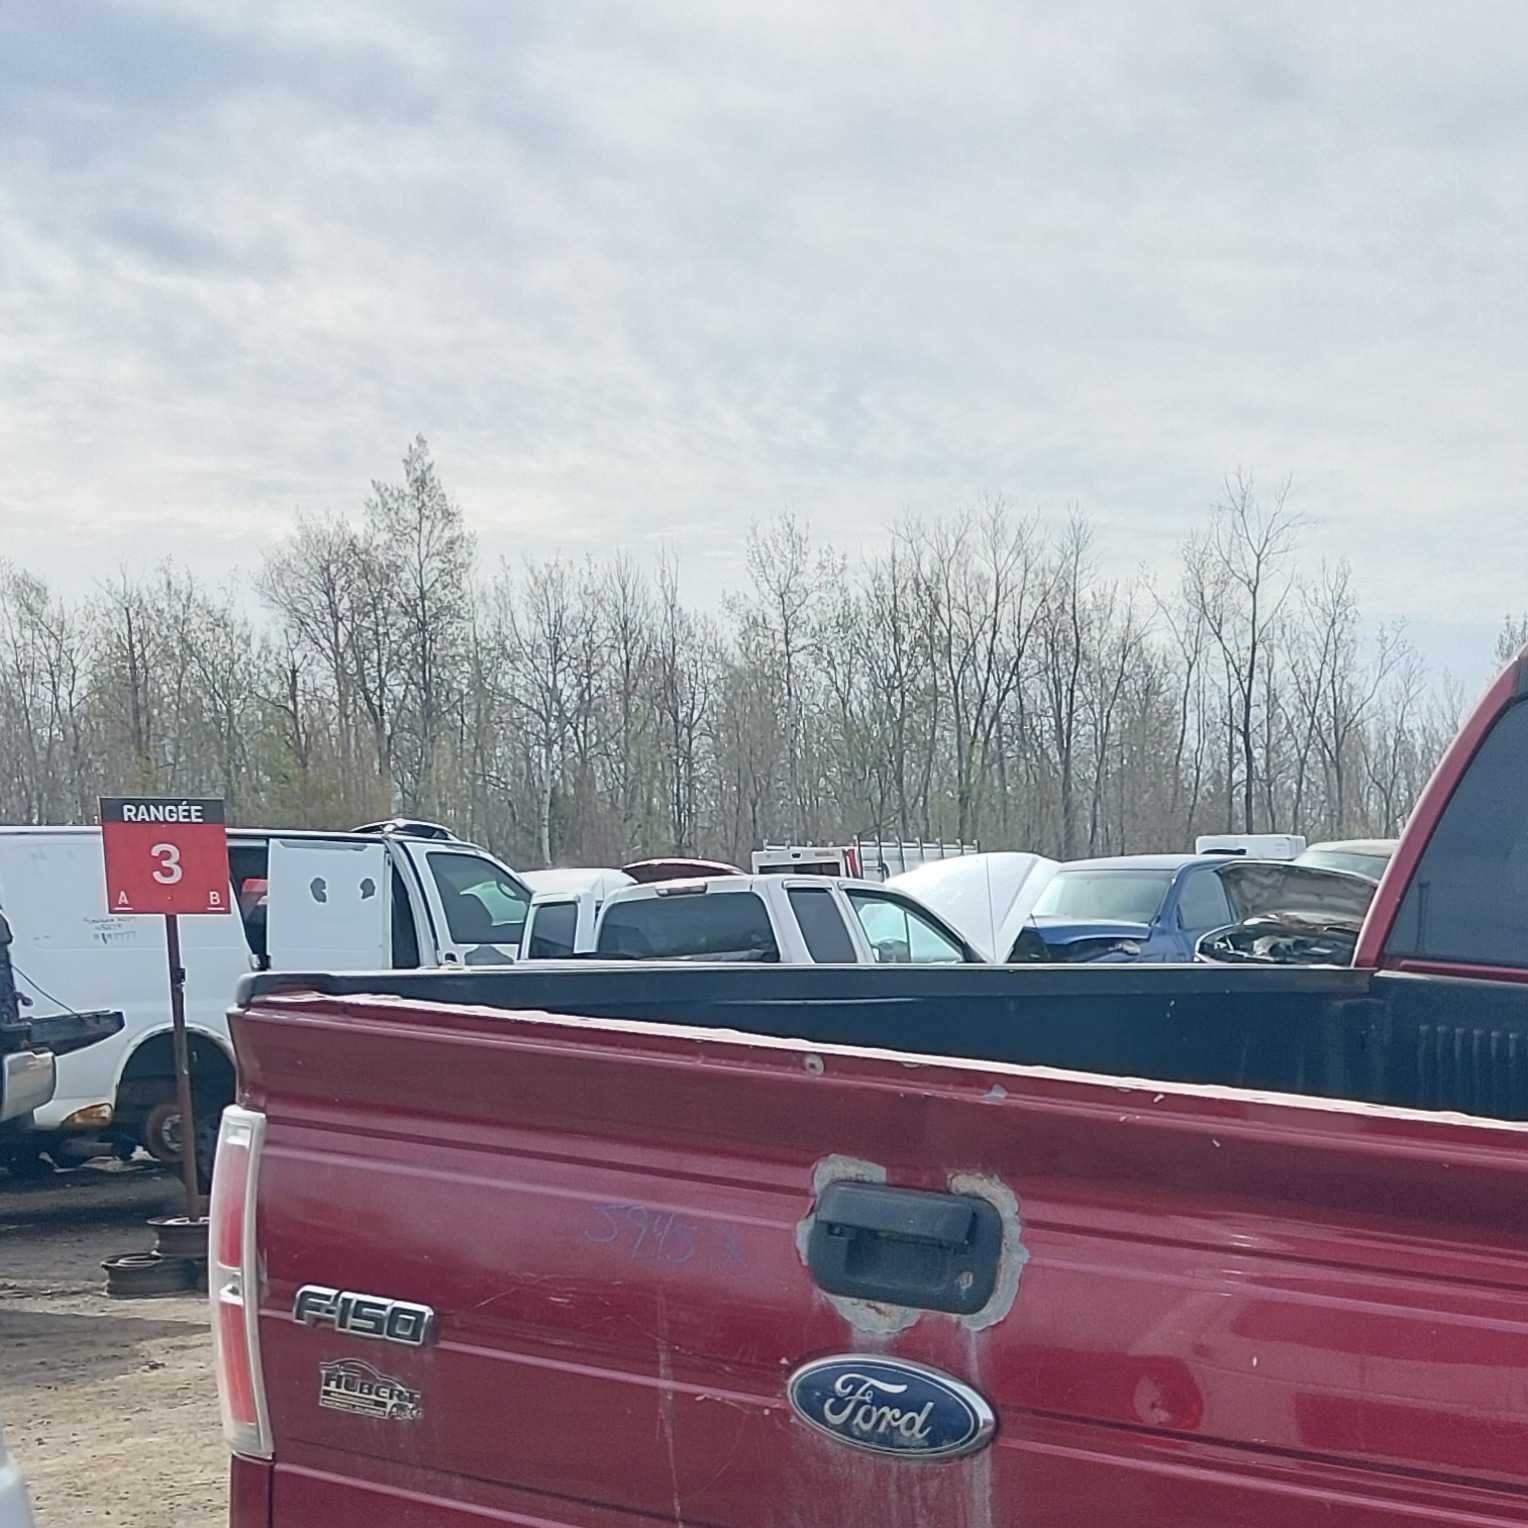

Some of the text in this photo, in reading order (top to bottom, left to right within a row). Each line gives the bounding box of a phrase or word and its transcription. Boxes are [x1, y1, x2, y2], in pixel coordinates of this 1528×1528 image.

[122, 801, 204, 823] RANGÉE
[151, 843, 183, 885] 3
[118, 891, 129, 905] A
[209, 891, 221, 905] B
[824, 1373, 935, 1439] Ford
